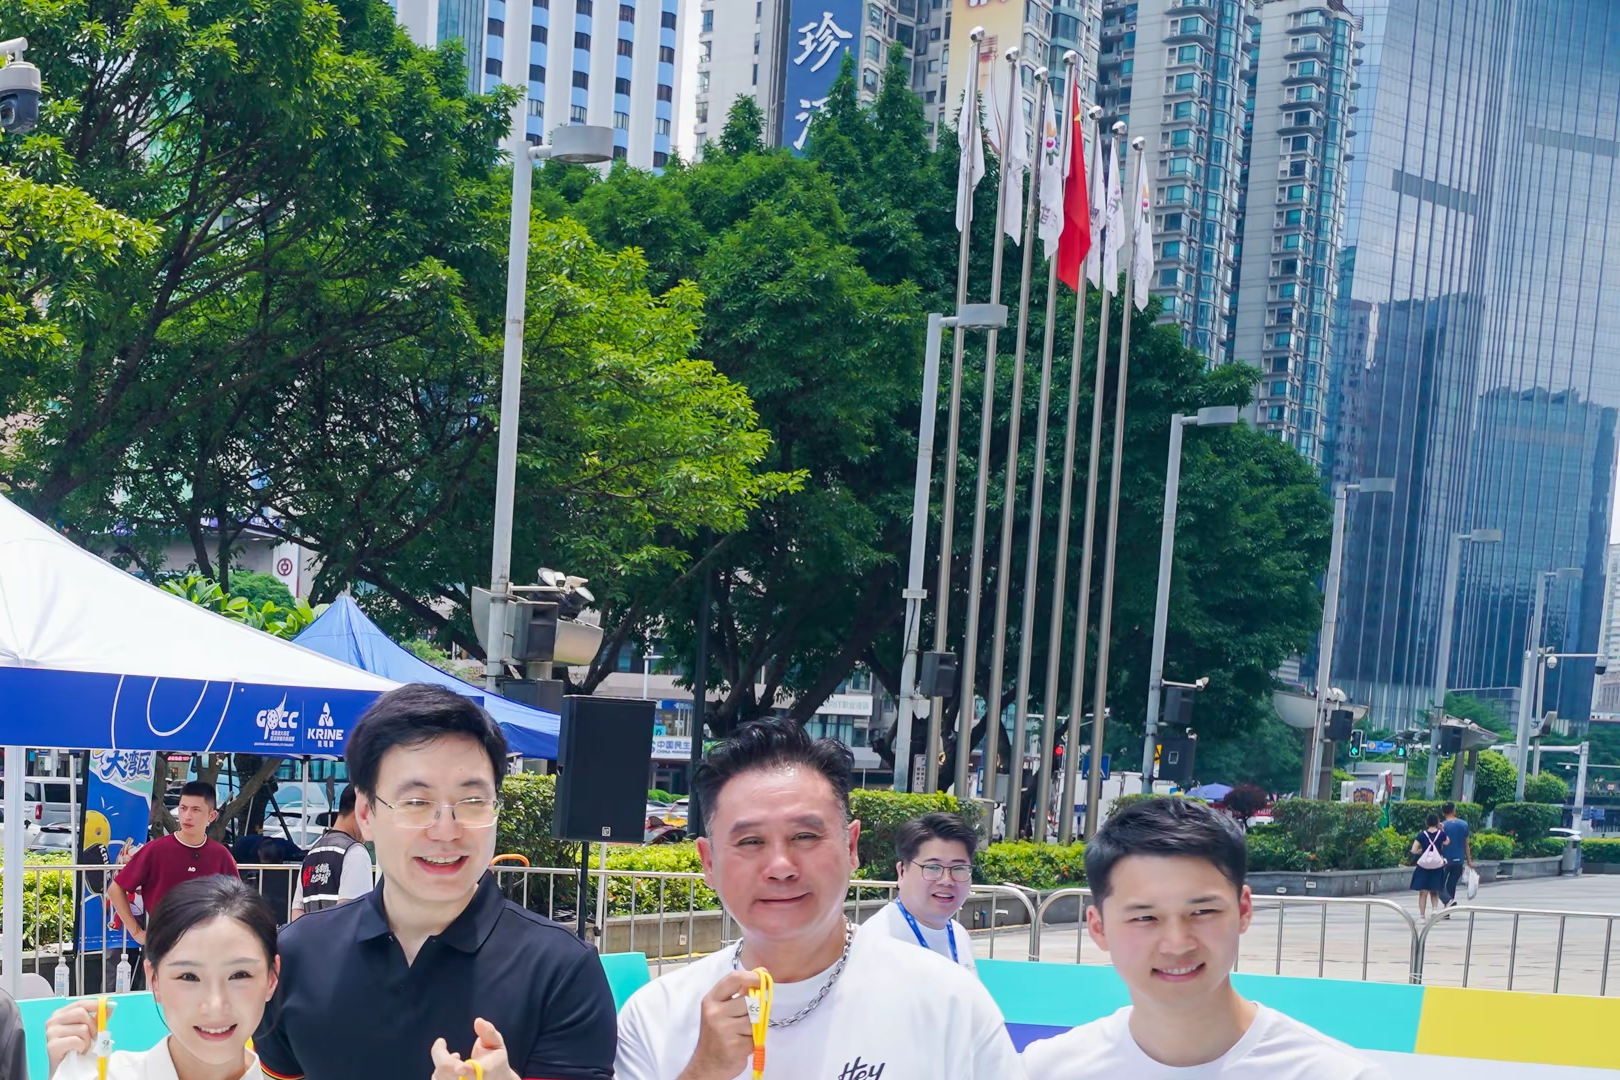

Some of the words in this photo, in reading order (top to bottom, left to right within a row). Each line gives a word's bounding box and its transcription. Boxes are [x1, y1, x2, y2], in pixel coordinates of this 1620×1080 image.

[307, 727, 345, 740] KRINE
[102, 750, 150, 778] 大湾区
